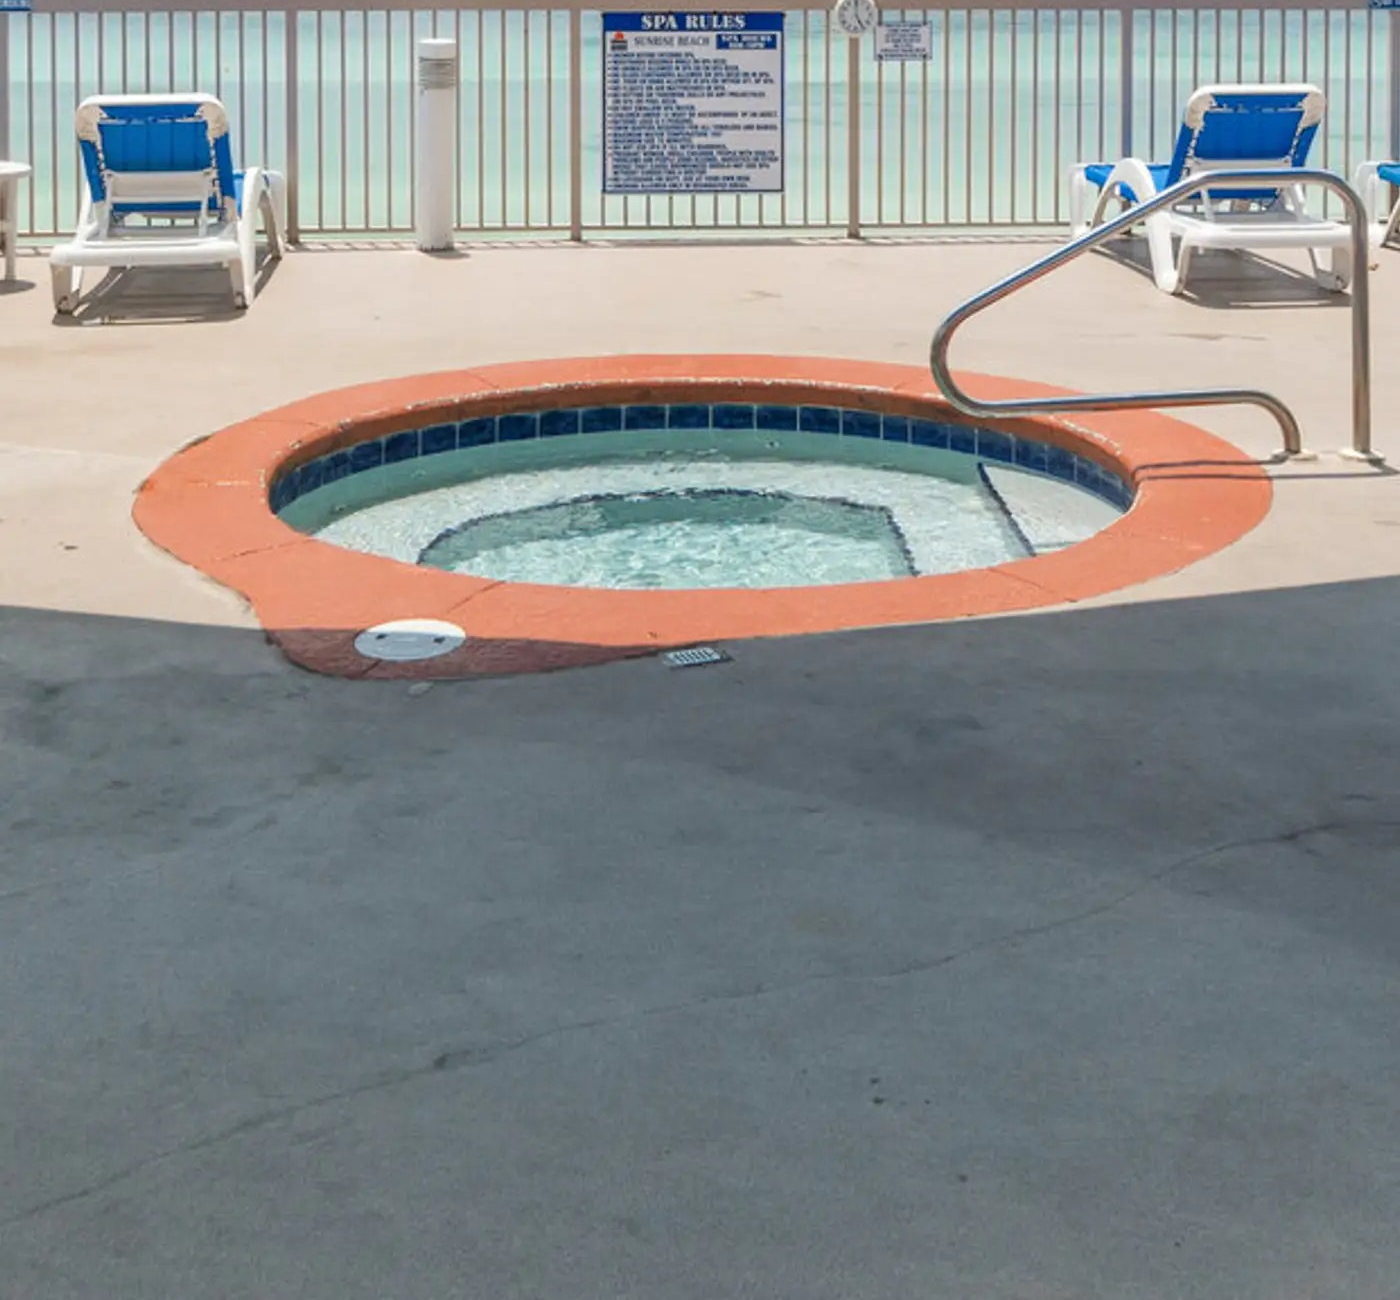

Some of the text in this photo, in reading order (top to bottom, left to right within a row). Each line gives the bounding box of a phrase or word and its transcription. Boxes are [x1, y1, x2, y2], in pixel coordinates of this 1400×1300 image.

[641, 14, 746, 30] SPA RULES
[634, 36, 711, 46] SUNRISE BEACH
